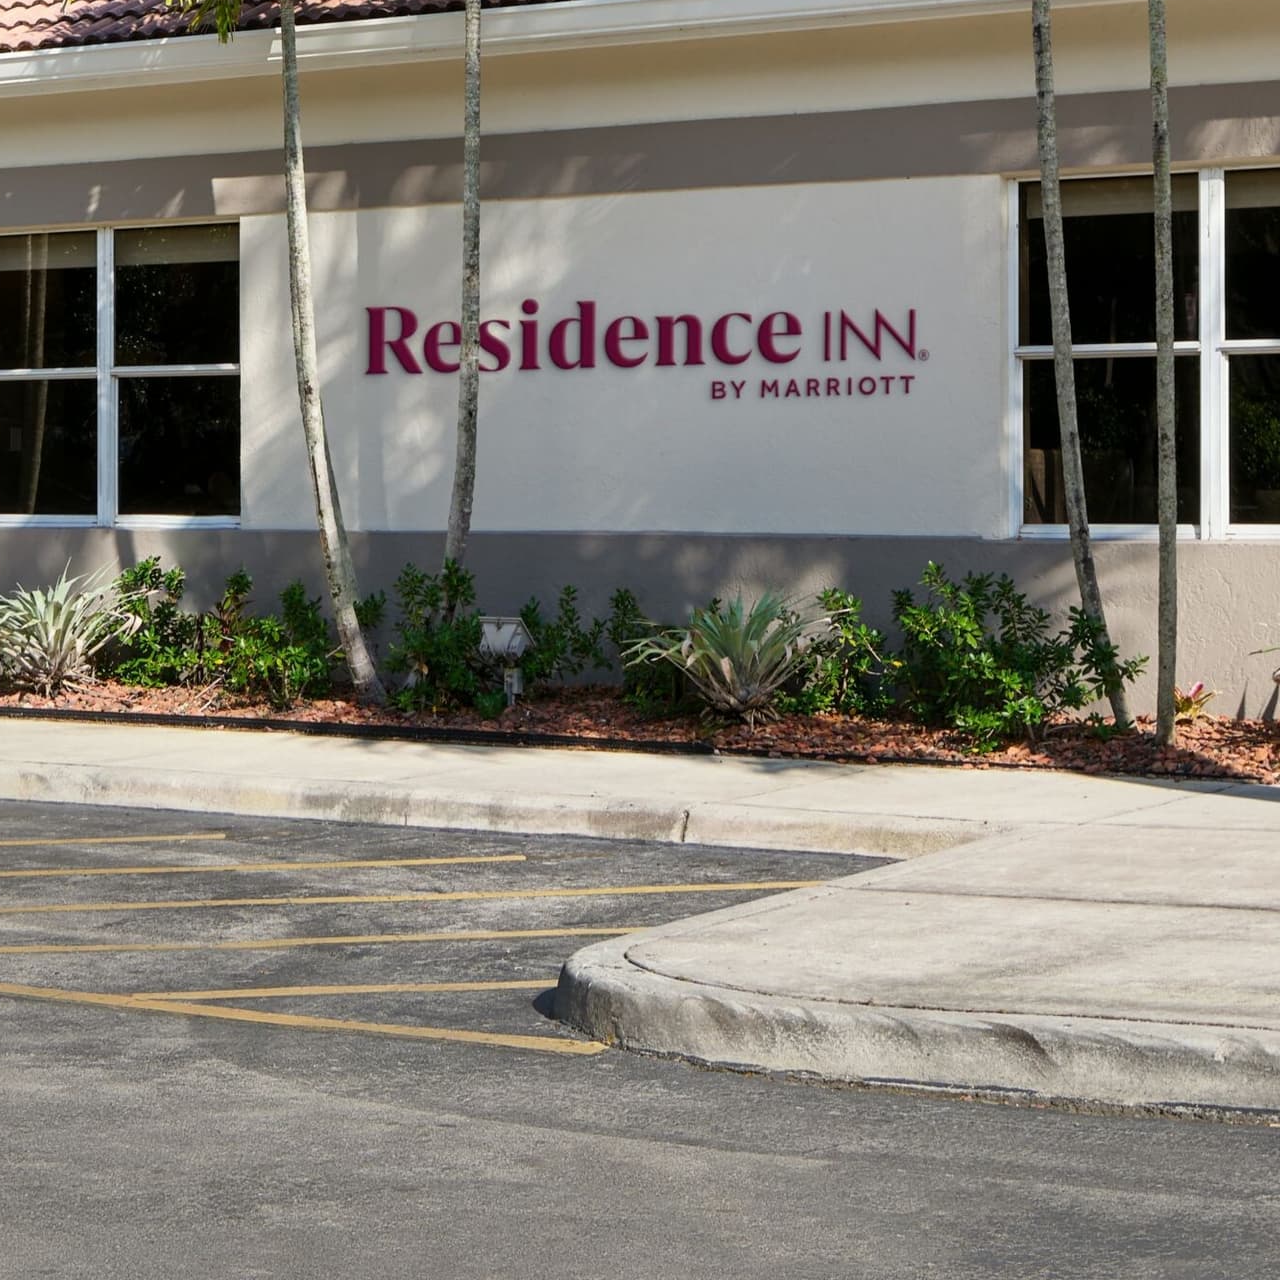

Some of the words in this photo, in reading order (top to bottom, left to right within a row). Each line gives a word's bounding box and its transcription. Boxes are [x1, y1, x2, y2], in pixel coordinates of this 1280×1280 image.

[365, 299, 803, 375] Residence
[711, 380, 746, 400] BY
[760, 375, 916, 398] MARRIOTT
